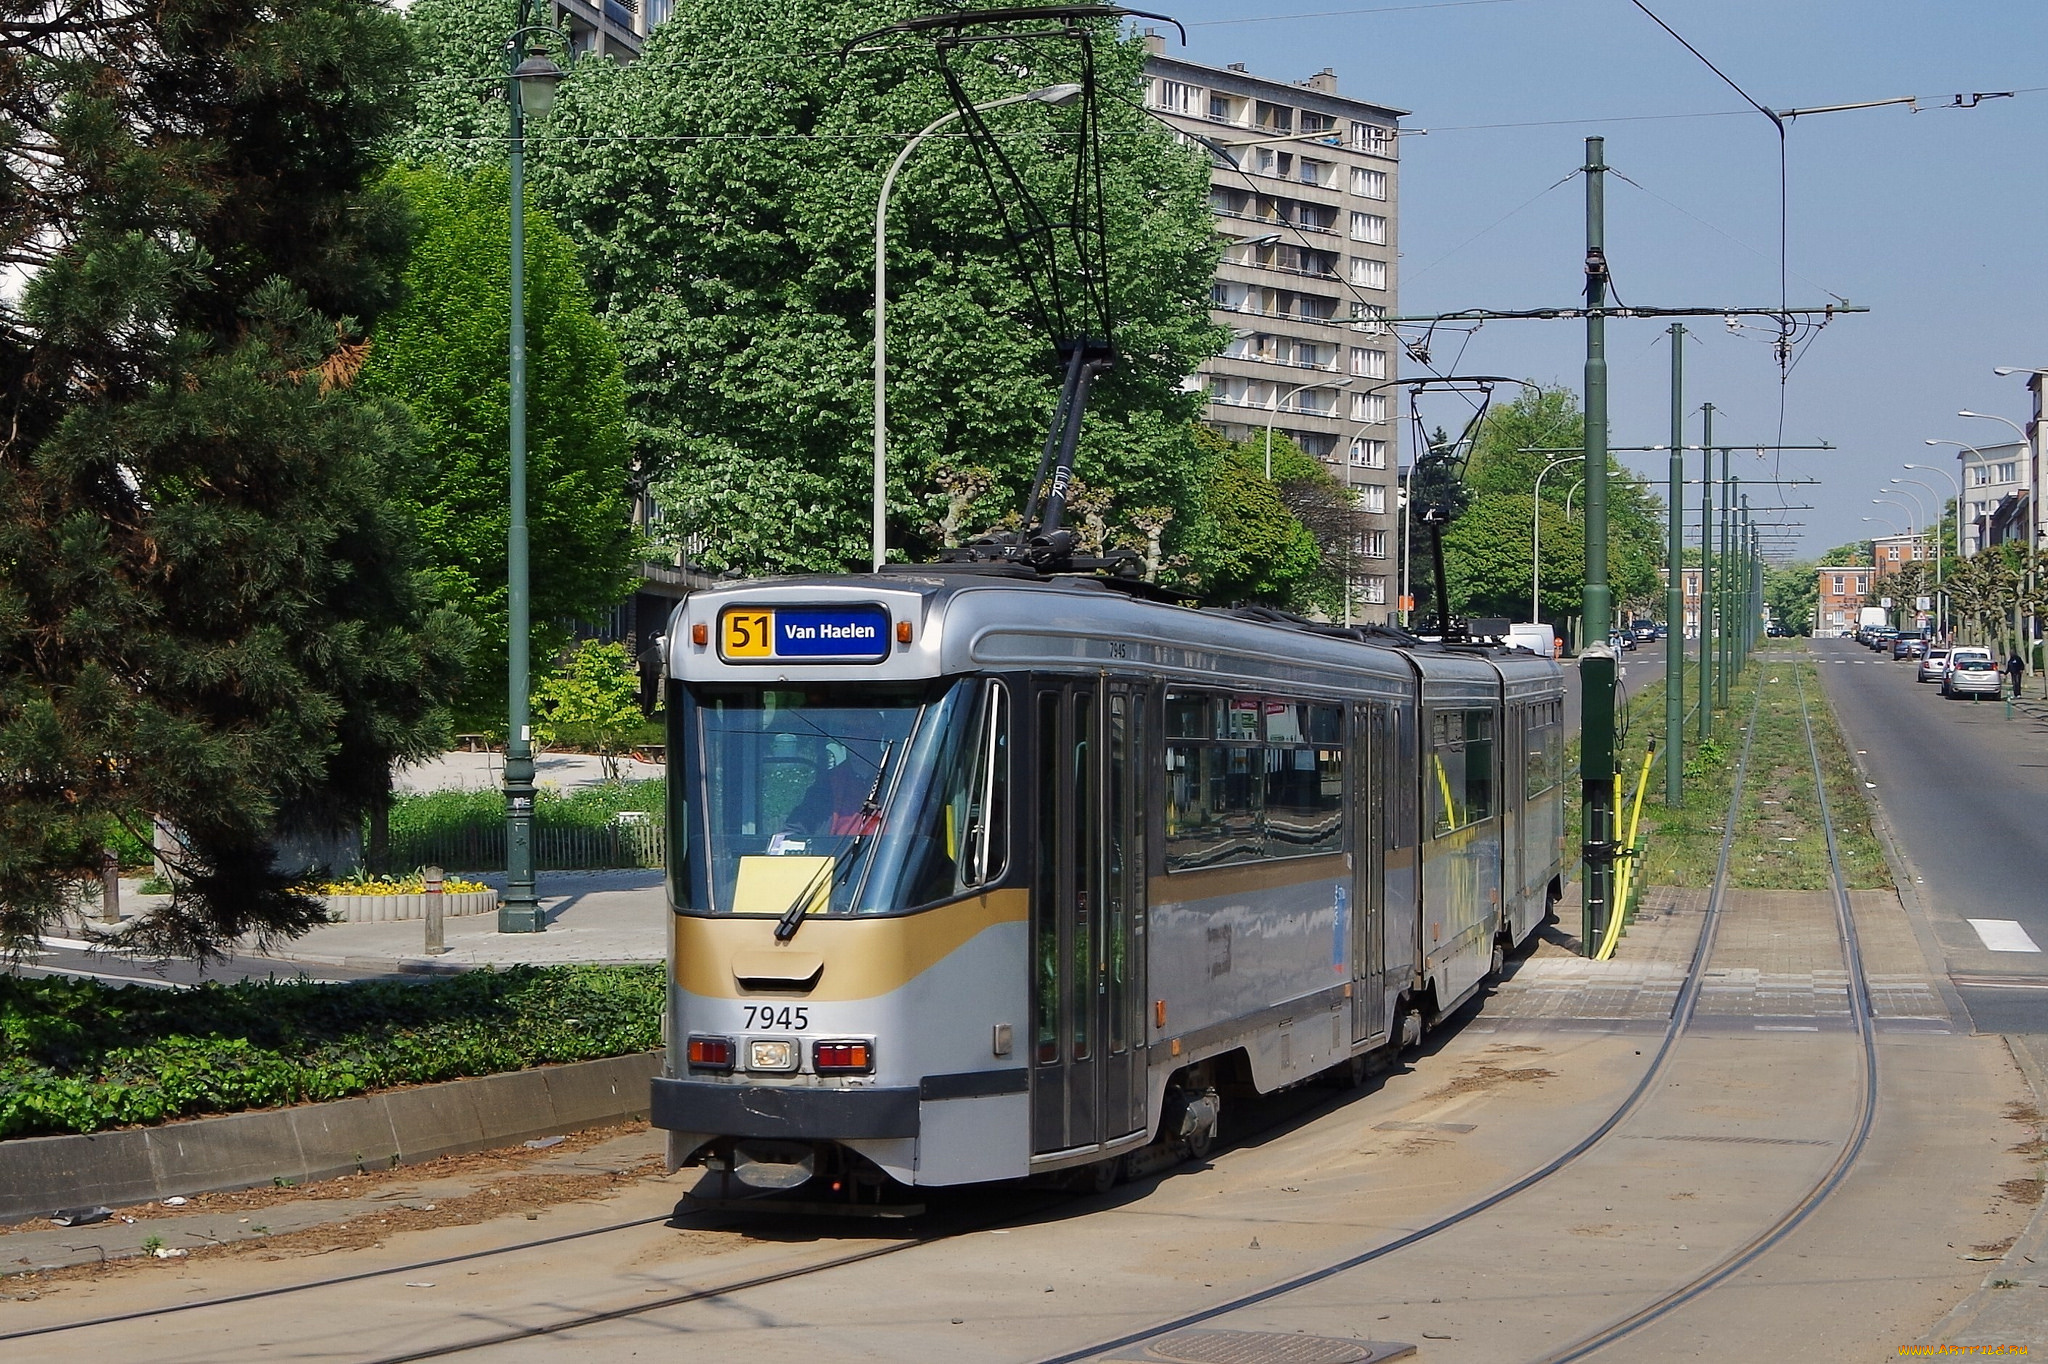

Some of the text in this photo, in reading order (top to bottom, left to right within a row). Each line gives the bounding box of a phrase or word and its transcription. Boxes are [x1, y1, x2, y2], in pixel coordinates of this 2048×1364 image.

[1003, 546, 1018, 556] 37
[731, 615, 769, 649] 51
[784, 622, 875, 640] Van Haelen
[1109, 641, 1127, 659] 7945
[743, 1005, 809, 1031] 7945
